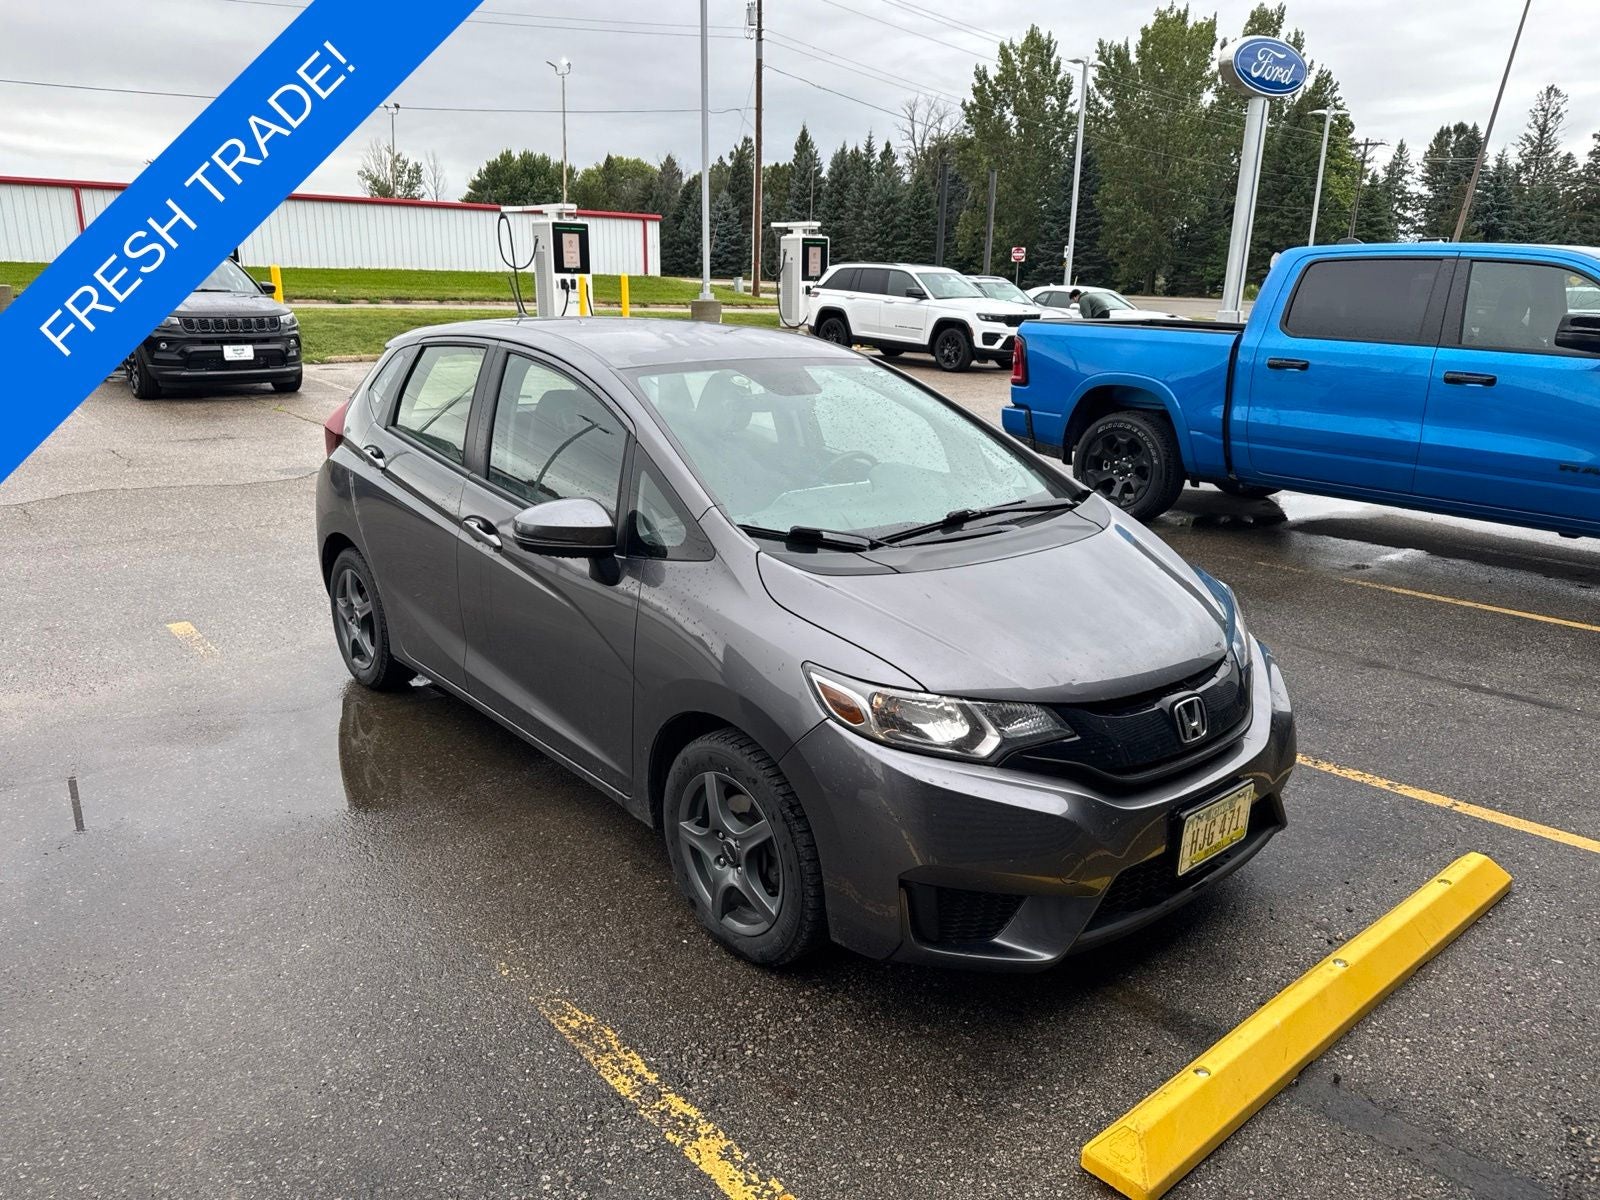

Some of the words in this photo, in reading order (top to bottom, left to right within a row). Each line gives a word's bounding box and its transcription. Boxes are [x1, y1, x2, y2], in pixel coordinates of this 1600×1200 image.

[1251, 47, 1295, 85] Ford
[1189, 821, 1215, 856] HJG
[1219, 805, 1241, 838] 471
